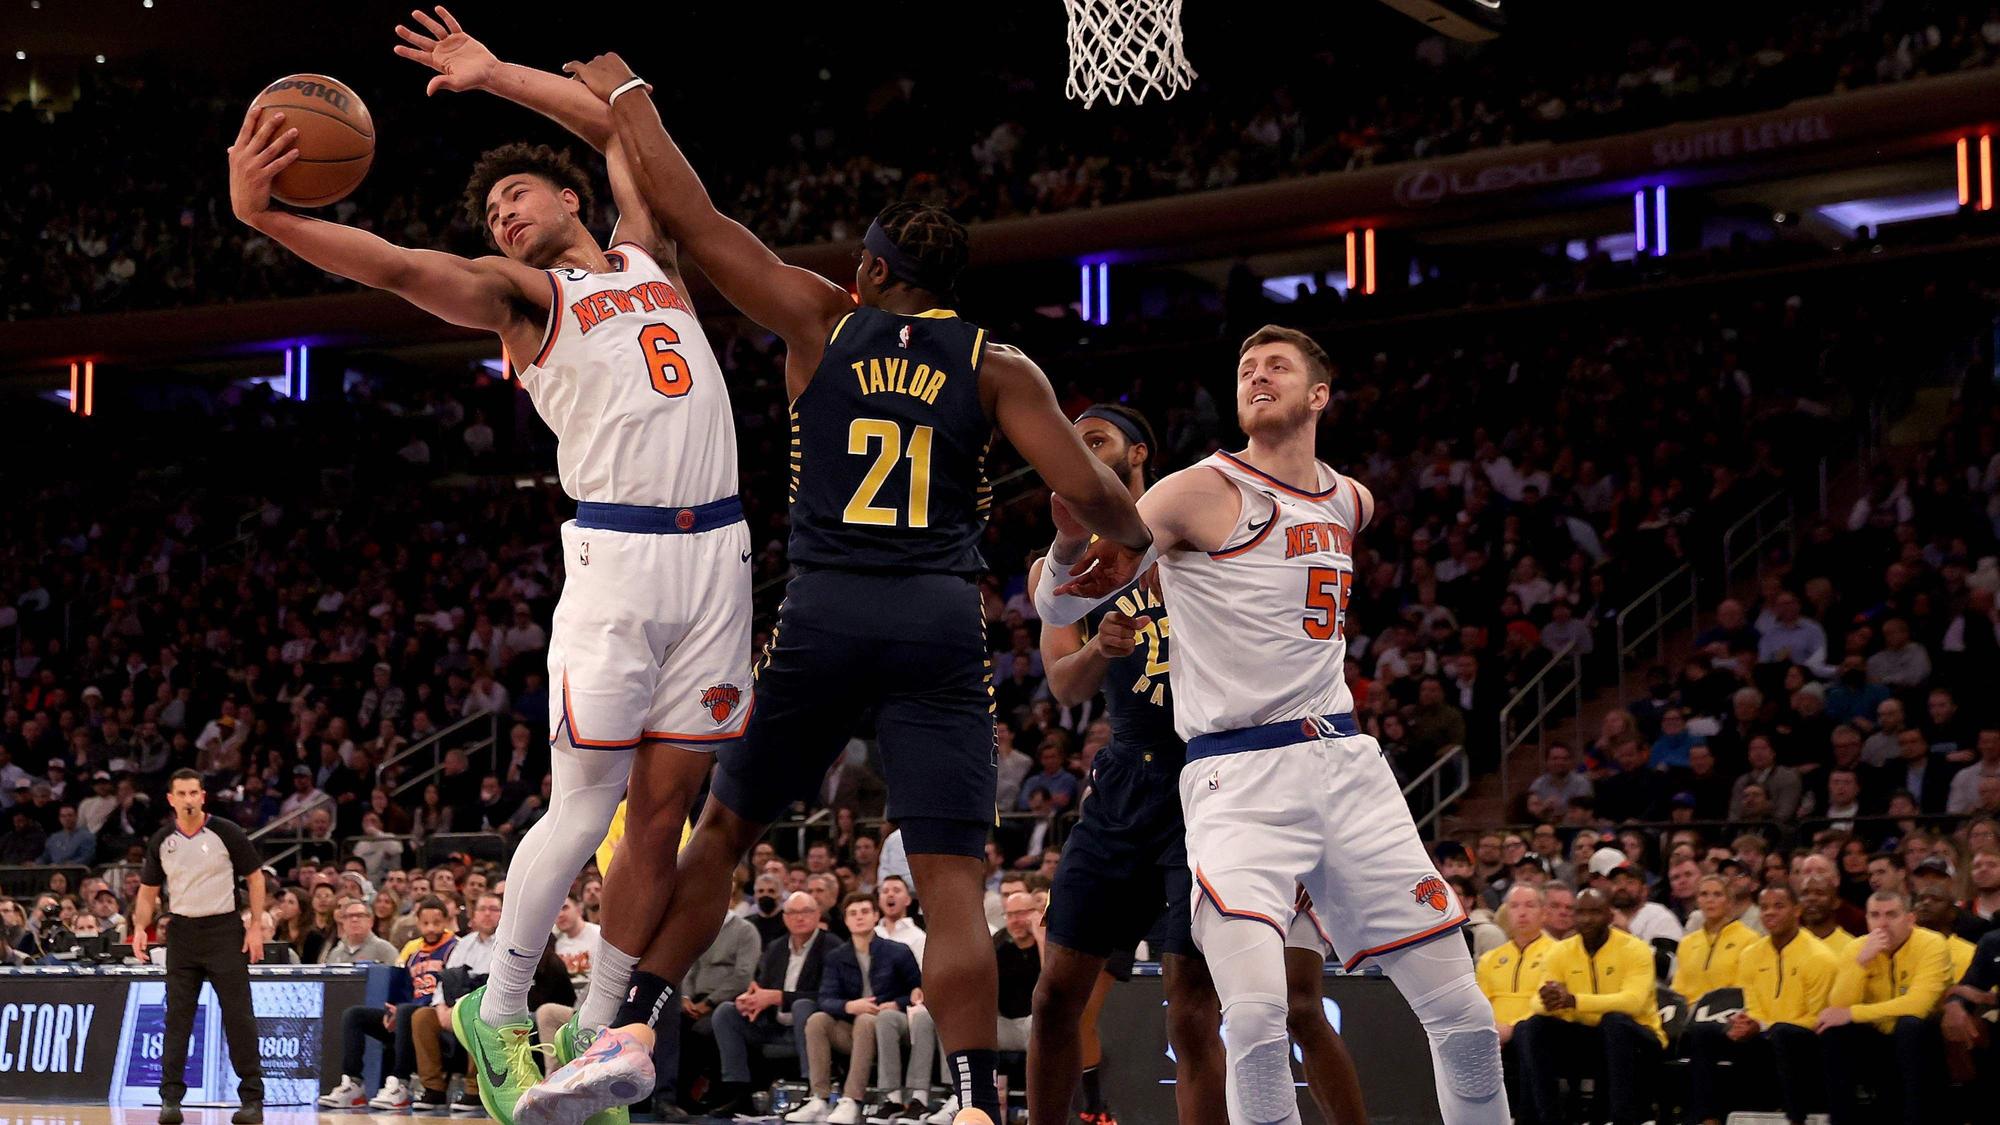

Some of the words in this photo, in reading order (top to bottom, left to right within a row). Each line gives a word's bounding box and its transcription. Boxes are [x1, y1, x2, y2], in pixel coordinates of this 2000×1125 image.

[265, 80, 350, 114] Wilson
[1652, 136, 1733, 166] SUITE
[1743, 115, 1832, 151] LEVEL
[1450, 152, 1602, 194] LEXUS
[570, 290, 636, 336] NEW
[638, 322, 693, 398] 6
[851, 358, 947, 405] TAYLOR
[842, 418, 934, 528] 21
[1285, 522, 1330, 560] NEW
[257, 1036, 300, 1058] 1800
